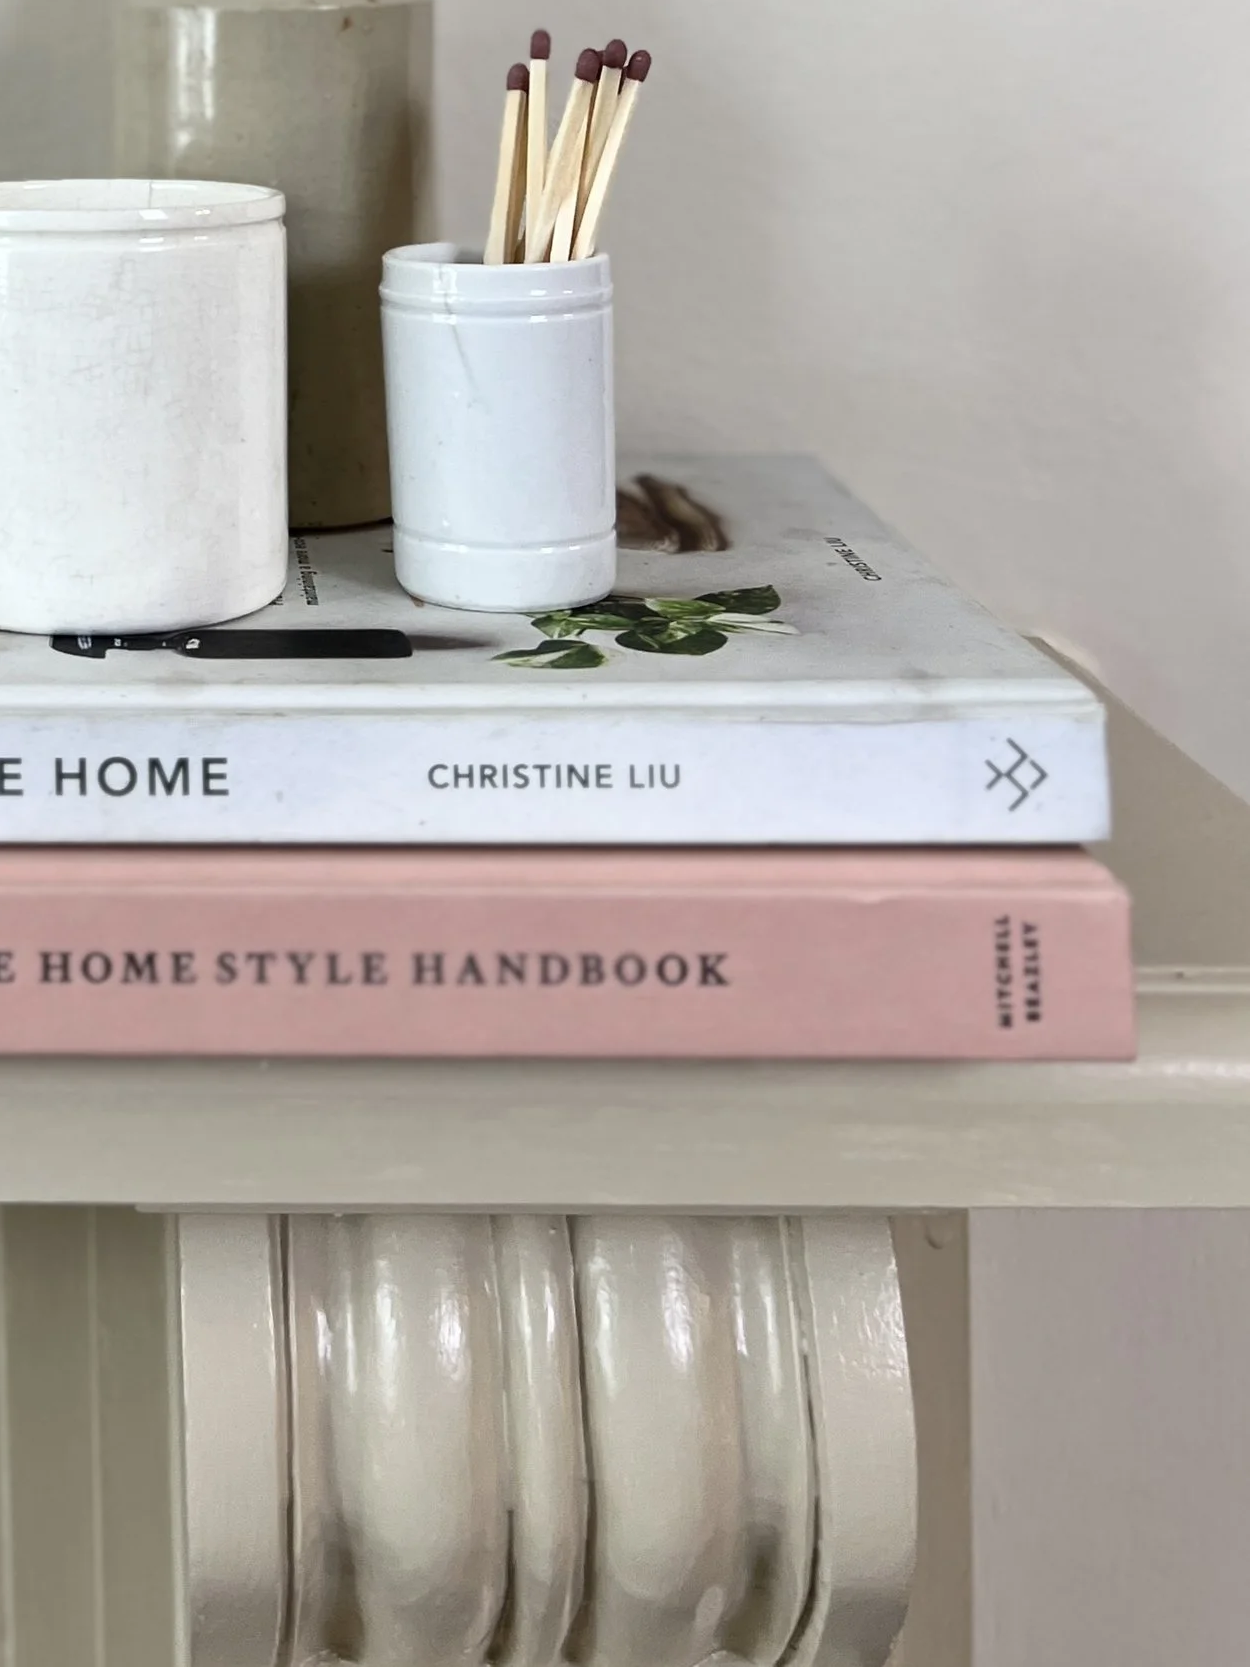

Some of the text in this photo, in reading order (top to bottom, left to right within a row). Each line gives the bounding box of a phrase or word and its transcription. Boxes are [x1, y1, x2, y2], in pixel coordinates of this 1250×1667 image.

[53, 755, 231, 798] HOME
[426, 762, 682, 790] CHRISTINE LIU
[37, 950, 198, 985] HOME
[214, 950, 389, 986] STYLE
[411, 951, 731, 987] HANDBOOK
[993, 914, 1014, 1029] MITCHELL
[1022, 920, 1041, 1022] BEAZLEY
